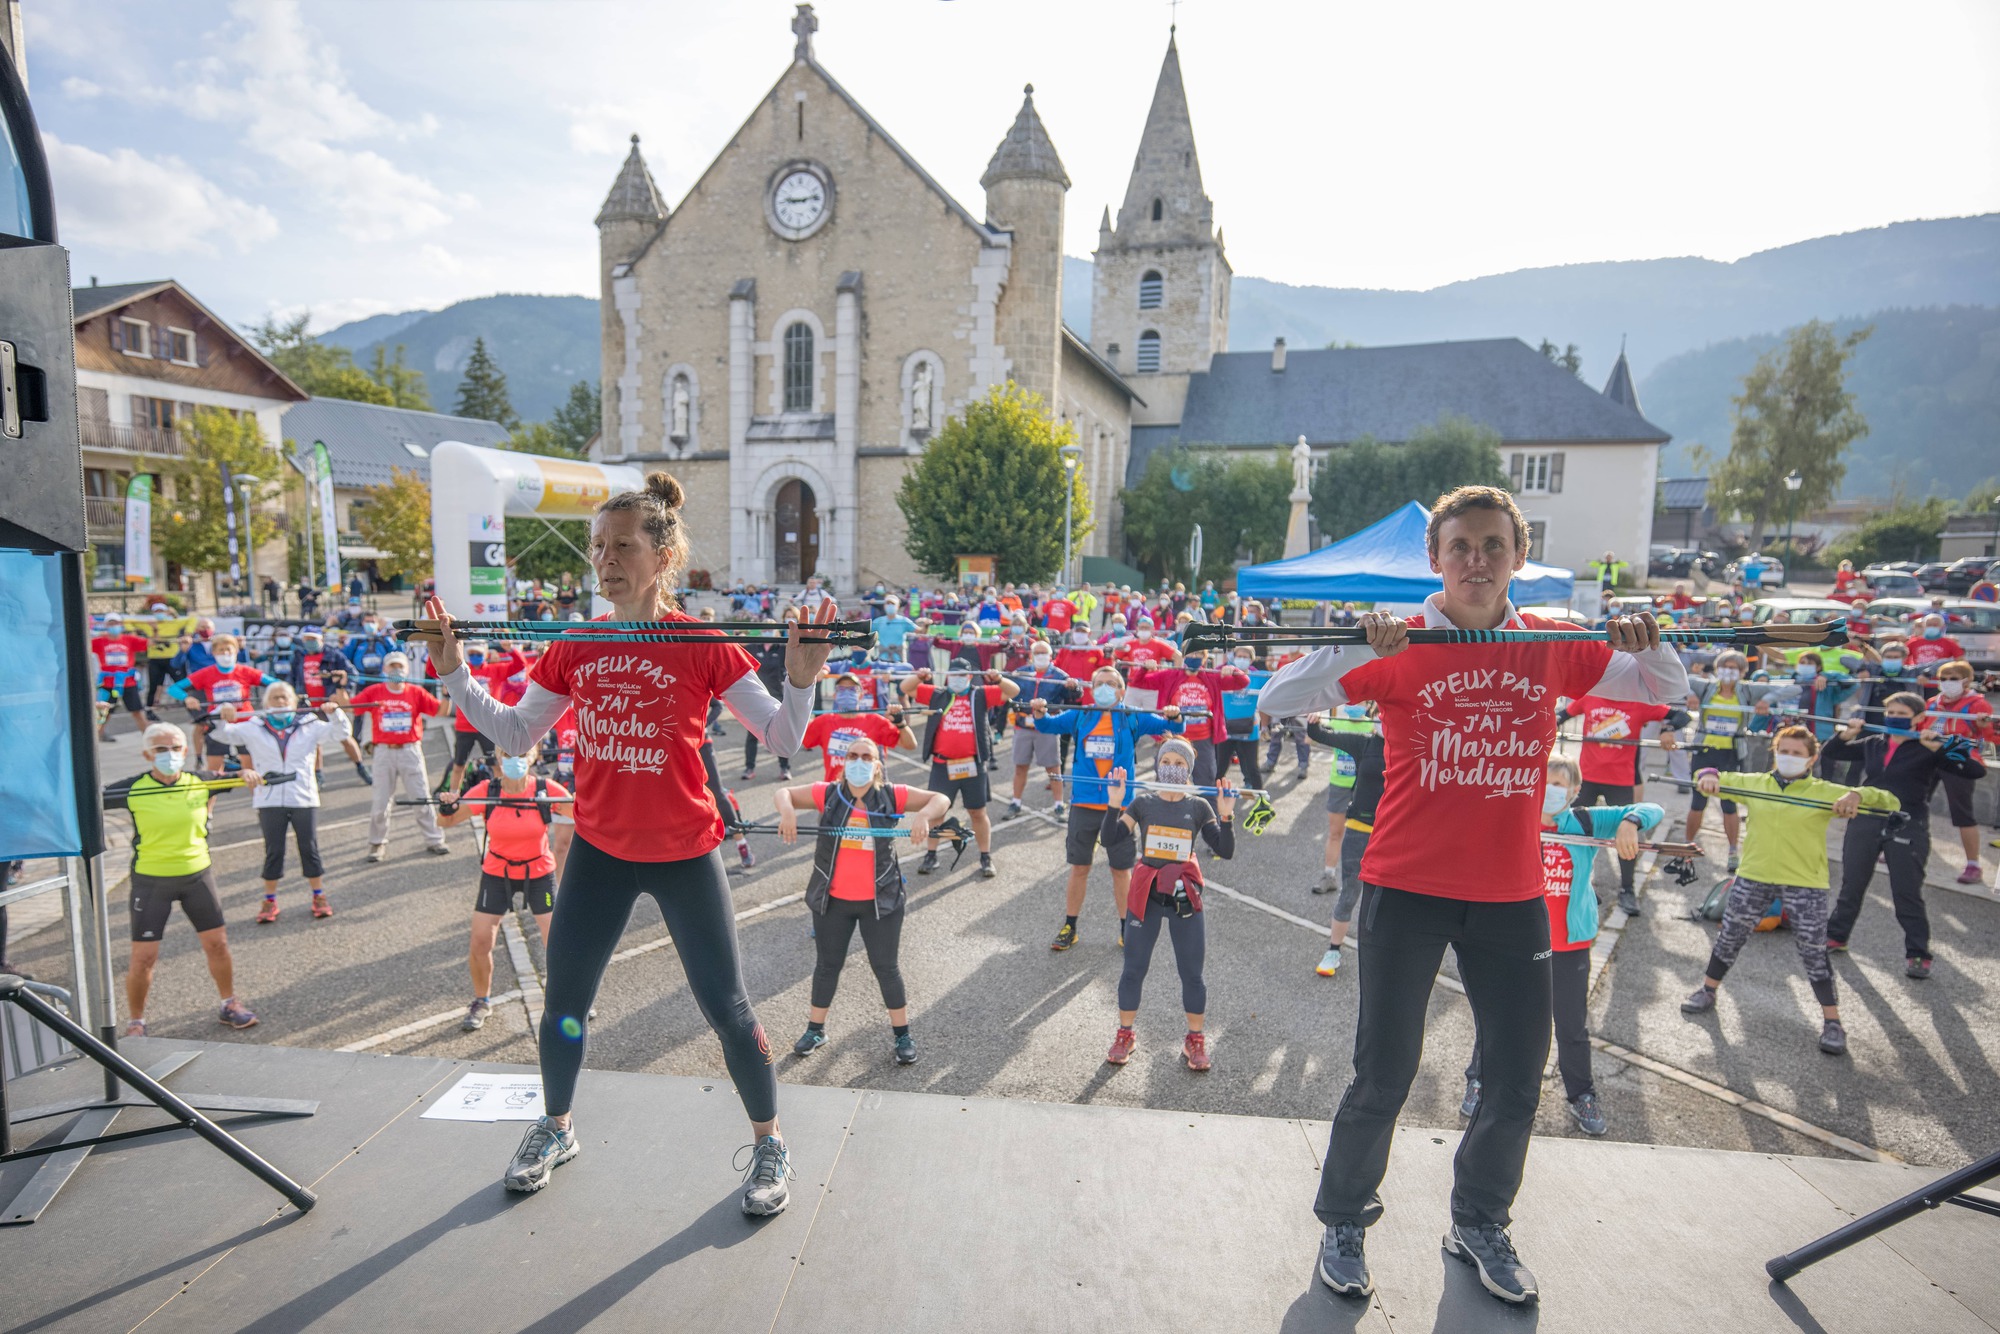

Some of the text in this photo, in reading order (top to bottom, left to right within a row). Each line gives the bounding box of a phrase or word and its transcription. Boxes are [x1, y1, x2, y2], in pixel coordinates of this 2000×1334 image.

[574, 655, 677, 689] J'PEUX PAS
[1417, 668, 1547, 708] J'PEUX PAS
[597, 694, 629, 714] J'AI
[578, 706, 660, 740] Marche
[1463, 714, 1502, 734] J'AI
[575, 733, 669, 774] Nordique
[1432, 728, 1544, 765] Marche
[1420, 757, 1541, 798] Nordique
[1157, 841, 1180, 851] 1351
